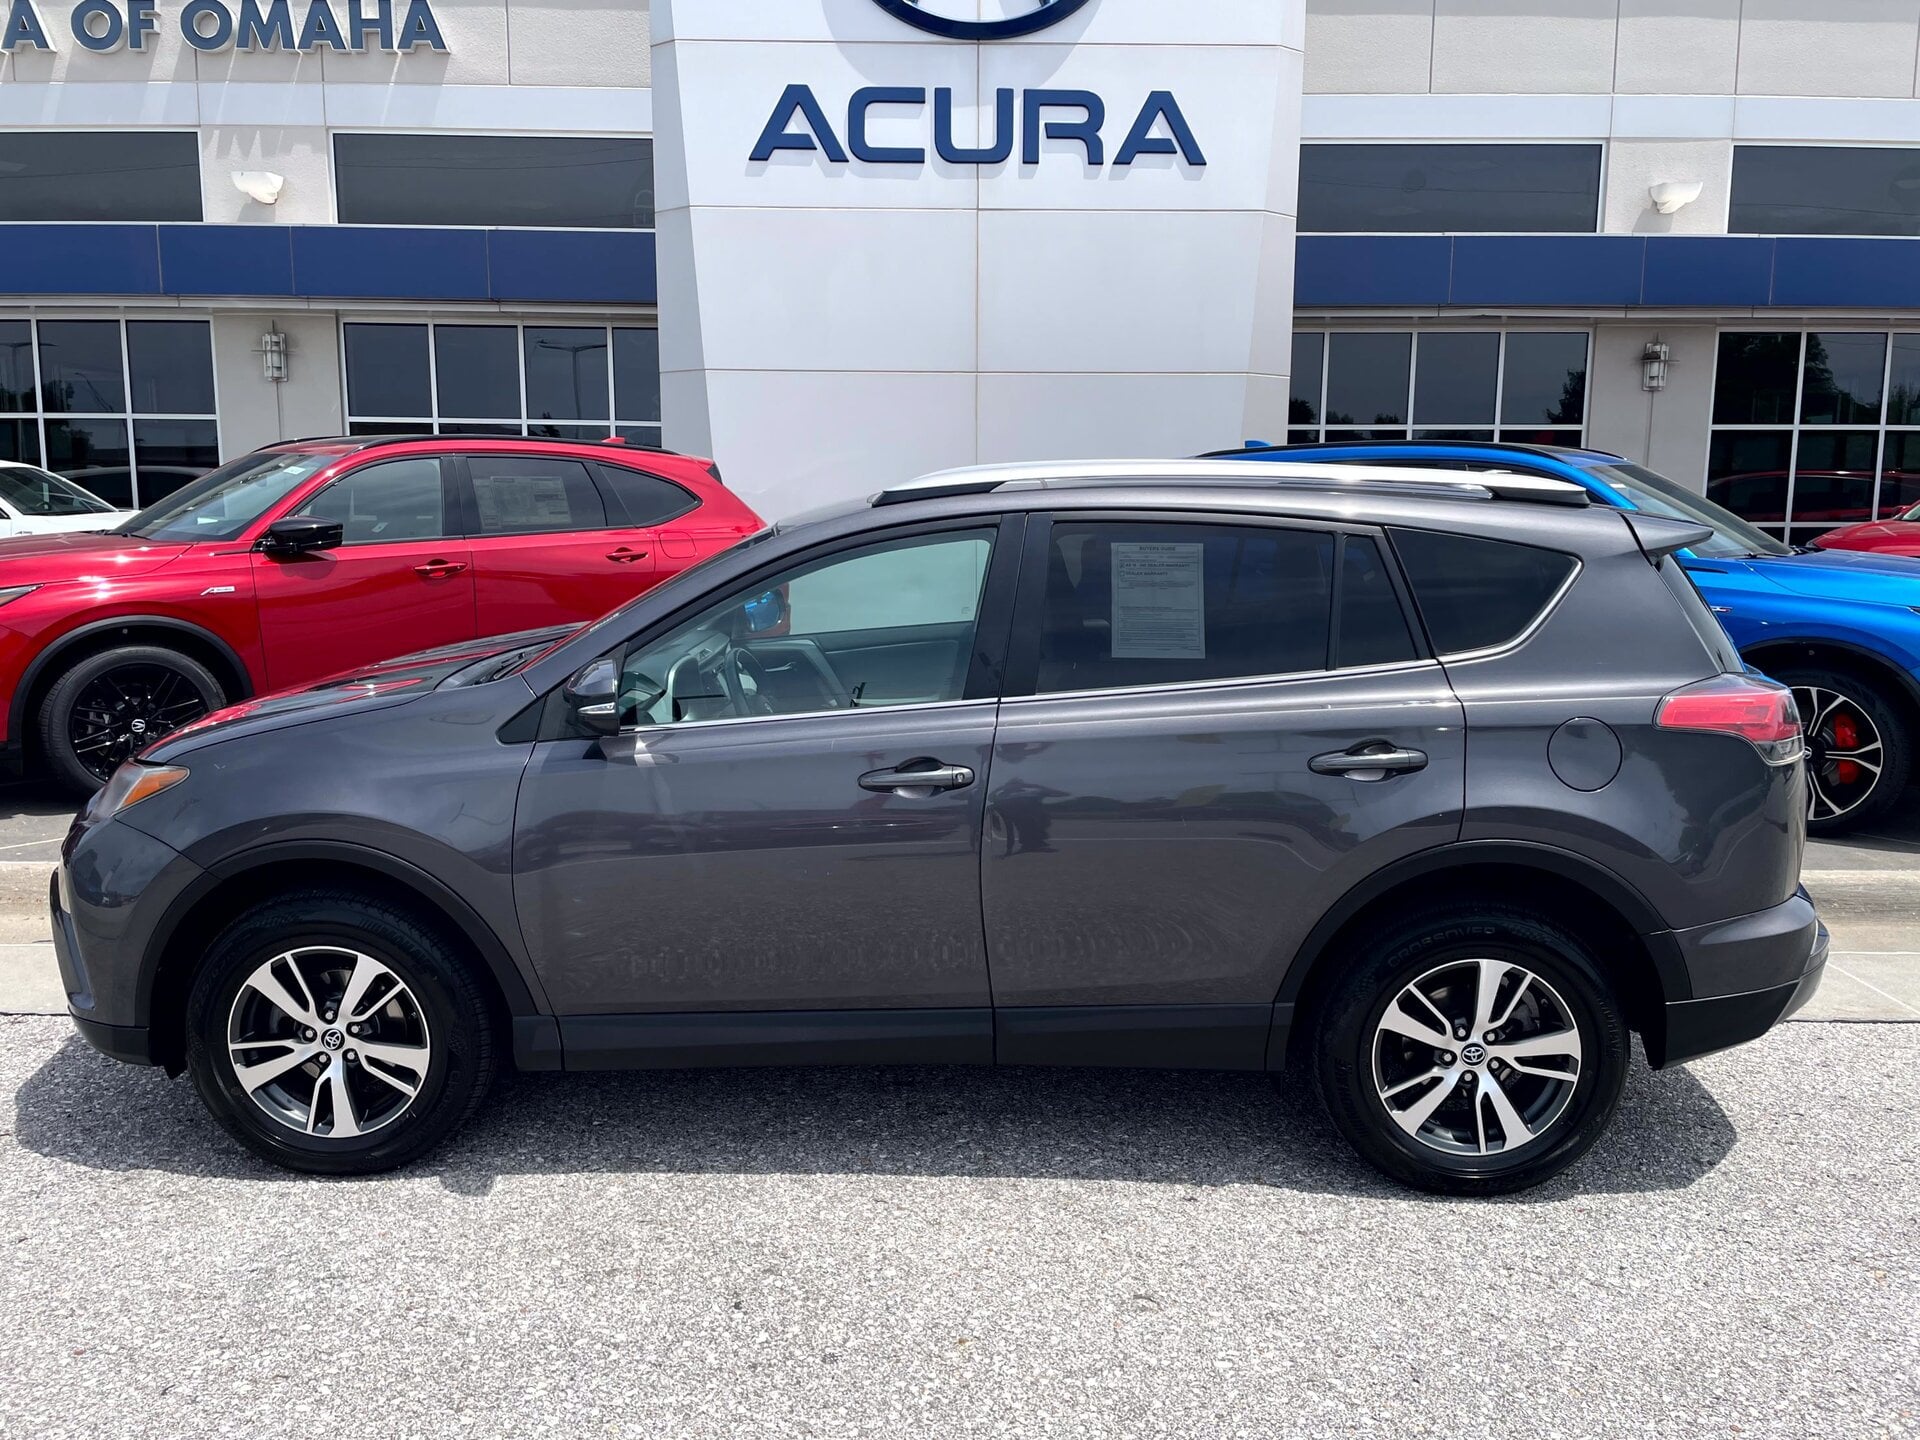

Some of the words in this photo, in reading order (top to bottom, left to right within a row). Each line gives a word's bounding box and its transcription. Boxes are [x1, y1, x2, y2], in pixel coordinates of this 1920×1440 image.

[70, 0, 157, 52] OF
[180, 0, 448, 51] OMAHA
[748, 83, 1207, 166] ACURA
[1387, 926, 1496, 968] CROSSOVER
